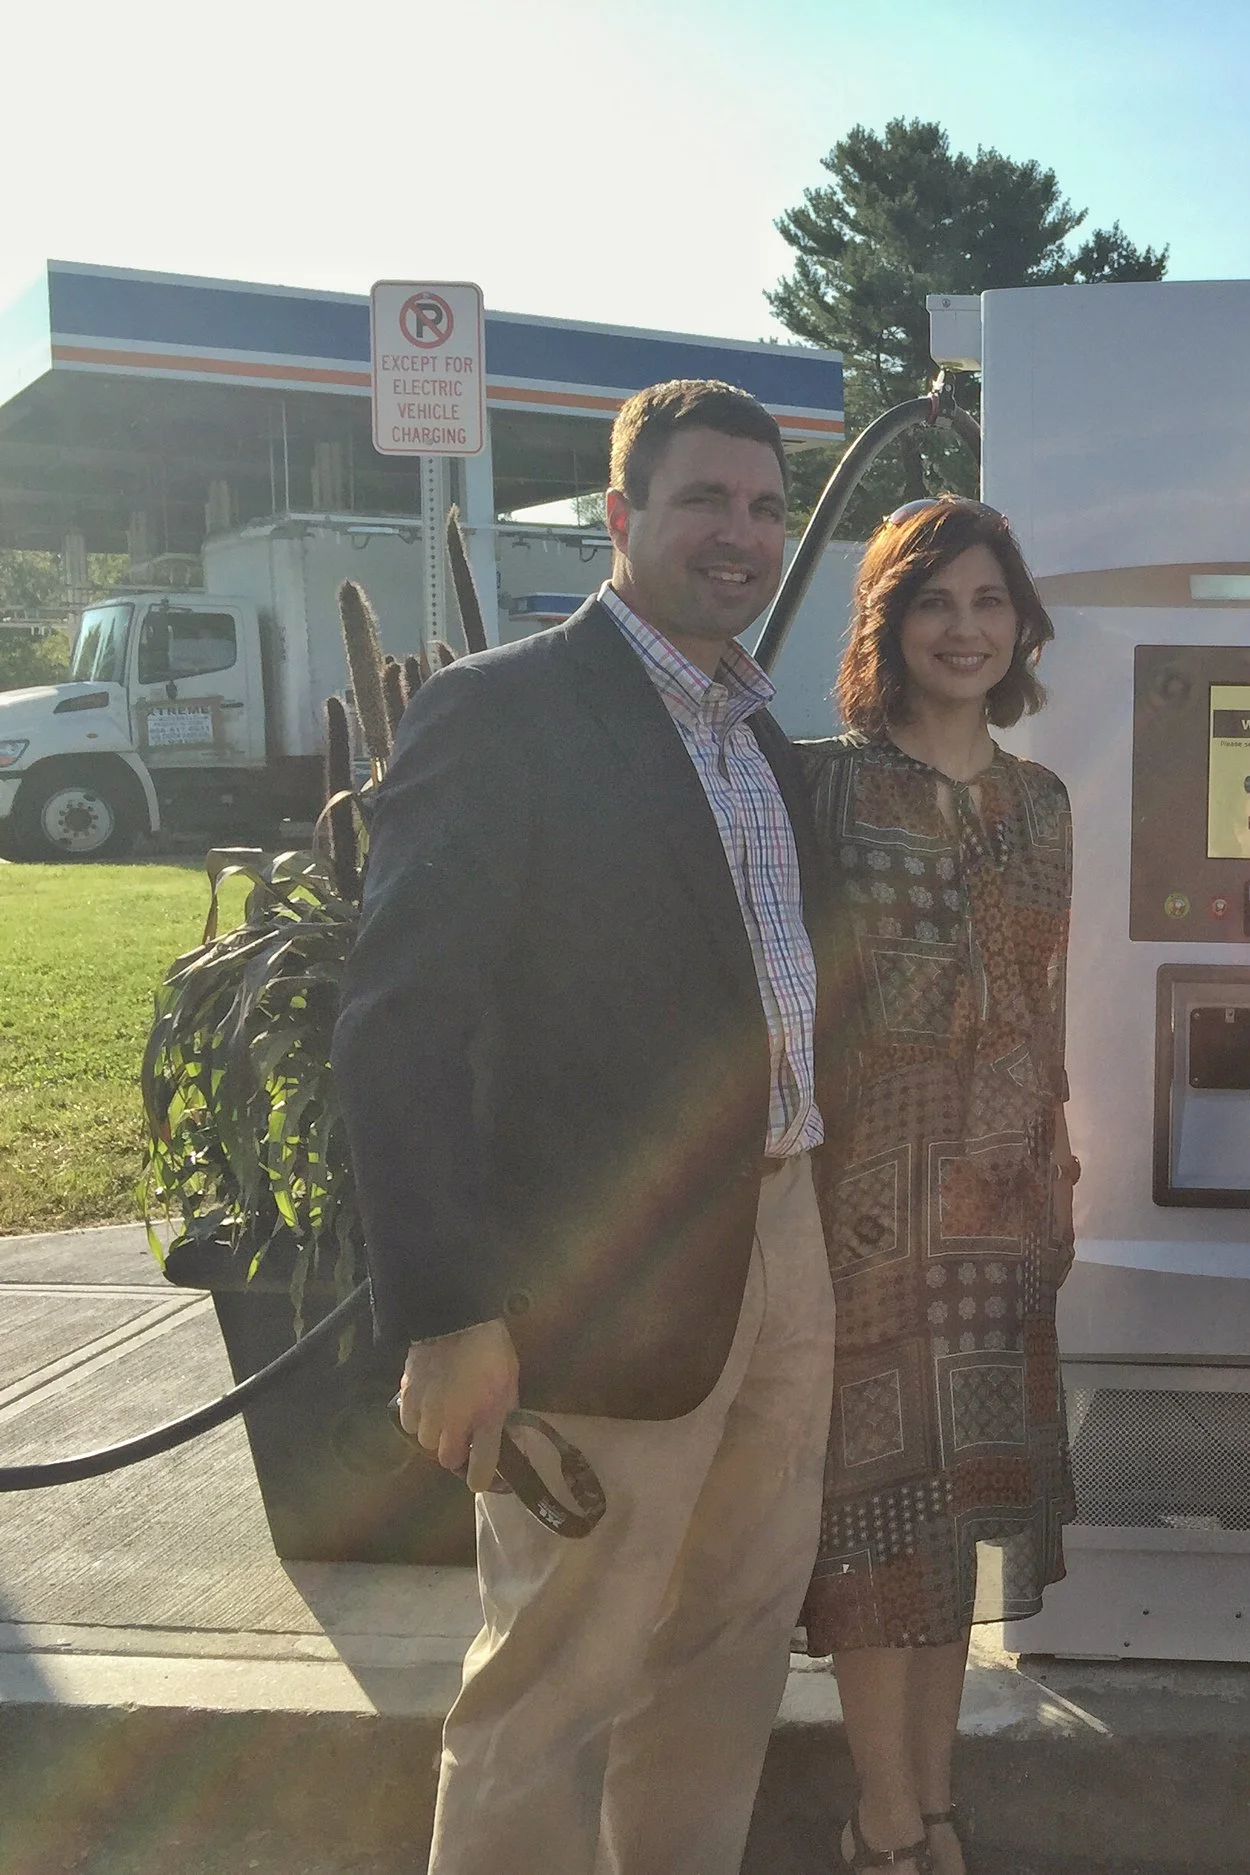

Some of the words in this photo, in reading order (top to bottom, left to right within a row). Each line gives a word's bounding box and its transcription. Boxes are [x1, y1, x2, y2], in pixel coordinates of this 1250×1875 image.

[382, 355, 437, 372] EXCEPT
[445, 357, 473, 373] FOR
[393, 379, 463, 397] ELECTRIC
[397, 403, 460, 420] VEHICLE
[392, 426, 466, 444] CHARGING
